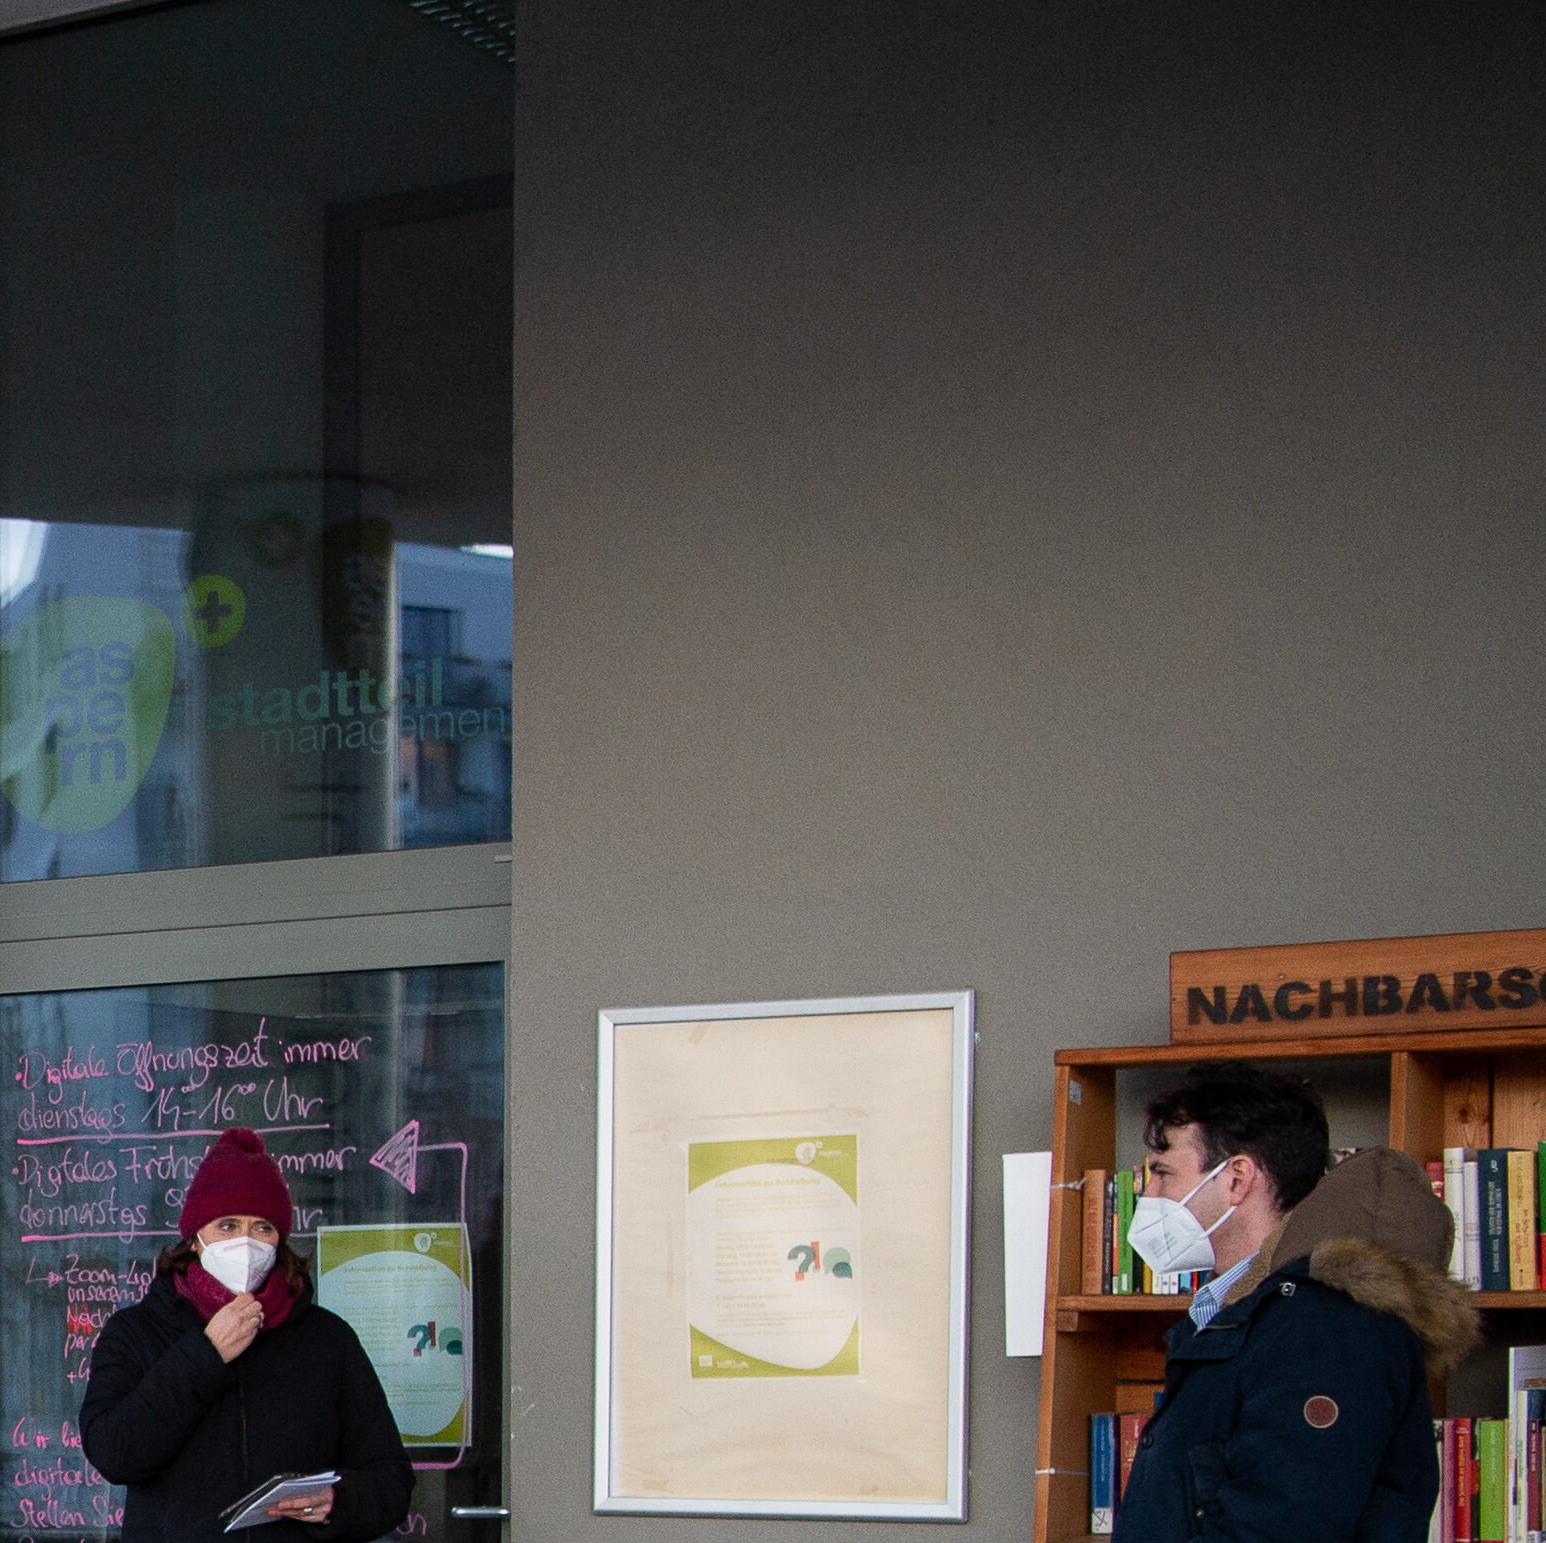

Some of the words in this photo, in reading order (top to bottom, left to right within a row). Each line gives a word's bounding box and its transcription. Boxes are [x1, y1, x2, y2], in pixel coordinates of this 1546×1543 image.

[208, 656, 443, 731] stadtteil
[259, 700, 507, 757] managemen
[1187, 967, 1546, 1026] NACHBARS
[17, 1045, 109, 1104] Digitale
[117, 1016, 269, 1091] Öffnungszeit
[279, 1036, 372, 1063] immer
[263, 1075, 324, 1123] Uhr
[12, 1416, 51, 1448] Wir
[10, 1498, 86, 1529] Stellen
[92, 1495, 124, 1527] Sie
